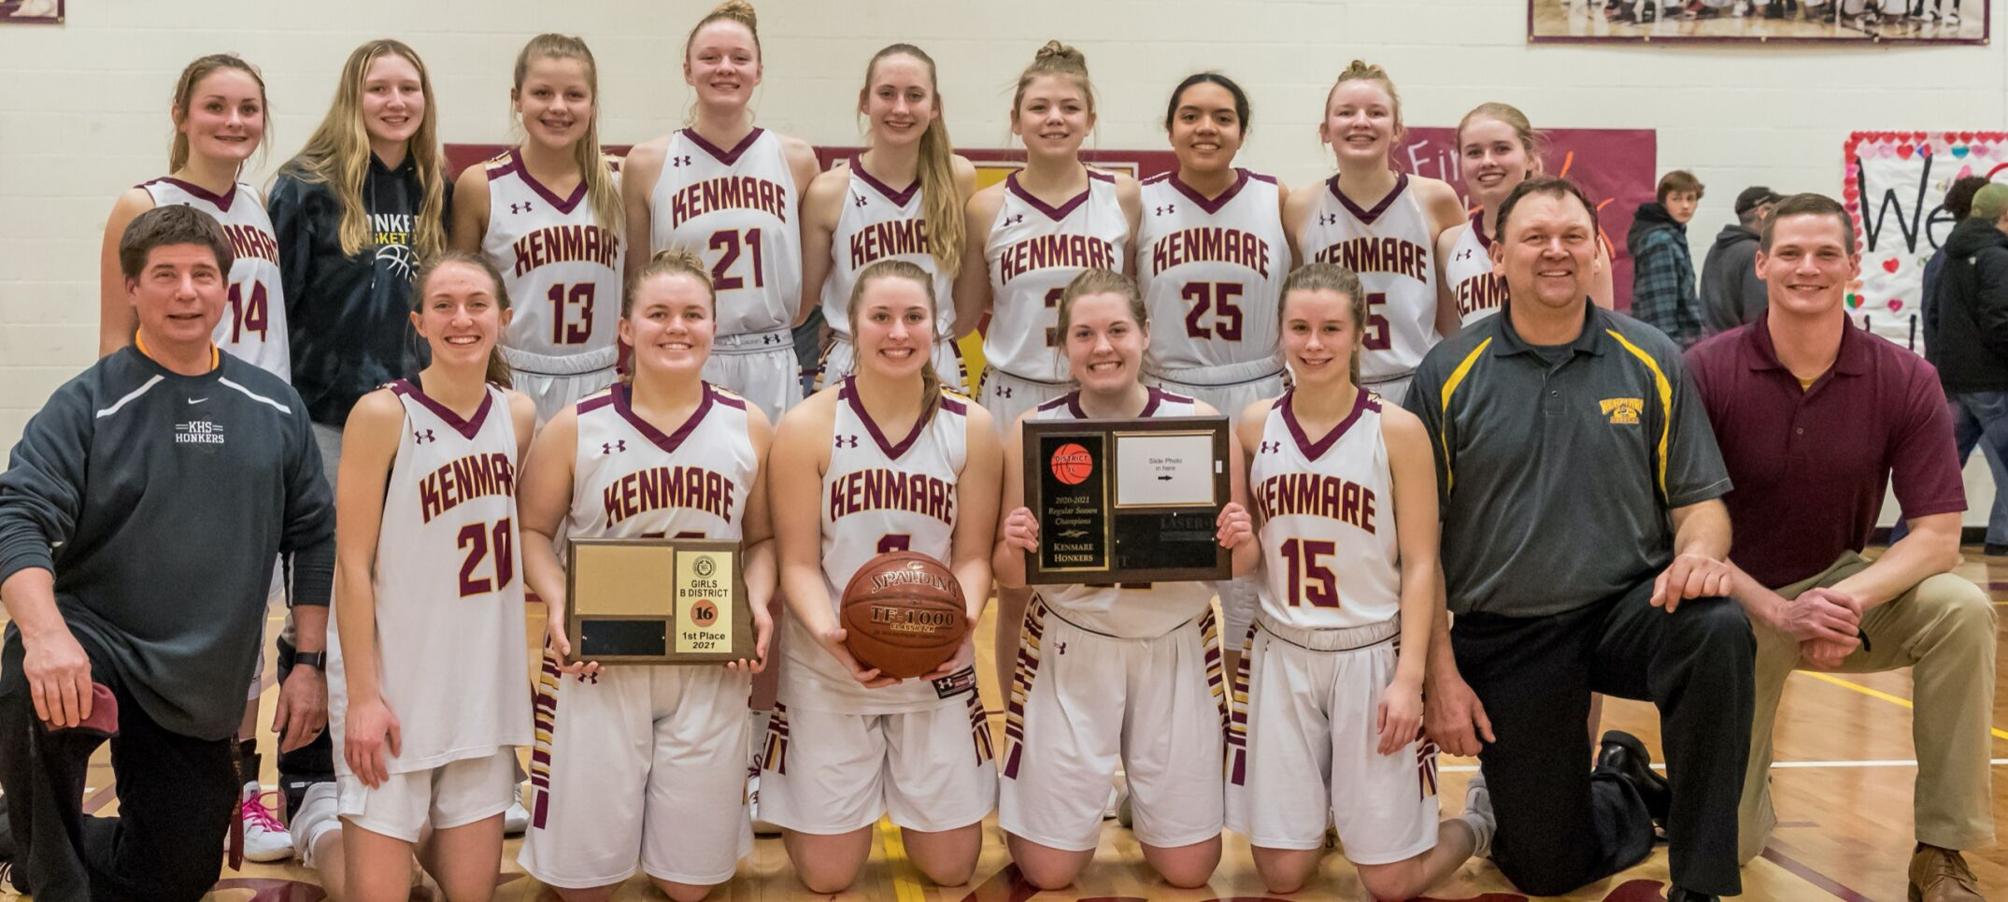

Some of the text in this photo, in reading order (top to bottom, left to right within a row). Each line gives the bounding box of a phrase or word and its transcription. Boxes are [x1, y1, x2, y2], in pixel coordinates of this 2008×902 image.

[671, 175, 786, 230] KENMARE
[708, 228, 764, 291] 21
[850, 218, 931, 272] KENMA
[999, 234, 1115, 287] KENMARE
[1152, 226, 1270, 281] KENMARE
[227, 279, 268, 344] 14
[547, 282, 596, 345] 13
[1181, 281, 1244, 342] 25
[175, 433, 225, 444] HONKERS
[188, 420, 212, 433] KHS
[418, 452, 515, 526] KENMAR
[603, 465, 735, 530] KENMARE
[830, 468, 954, 525] KENMARE
[1256, 472, 1376, 535] KENMARE
[457, 516, 513, 599] 20
[691, 579, 718, 588] GIRLS
[871, 569, 958, 598] SPALDING
[1280, 537, 1340, 609] 15
[680, 588, 728, 598] B DISTRICT
[695, 606, 714, 620] 16
[870, 606, 955, 626] TF-1000
[682, 631, 726, 640] 1st Place
[692, 641, 716, 650] 2021
